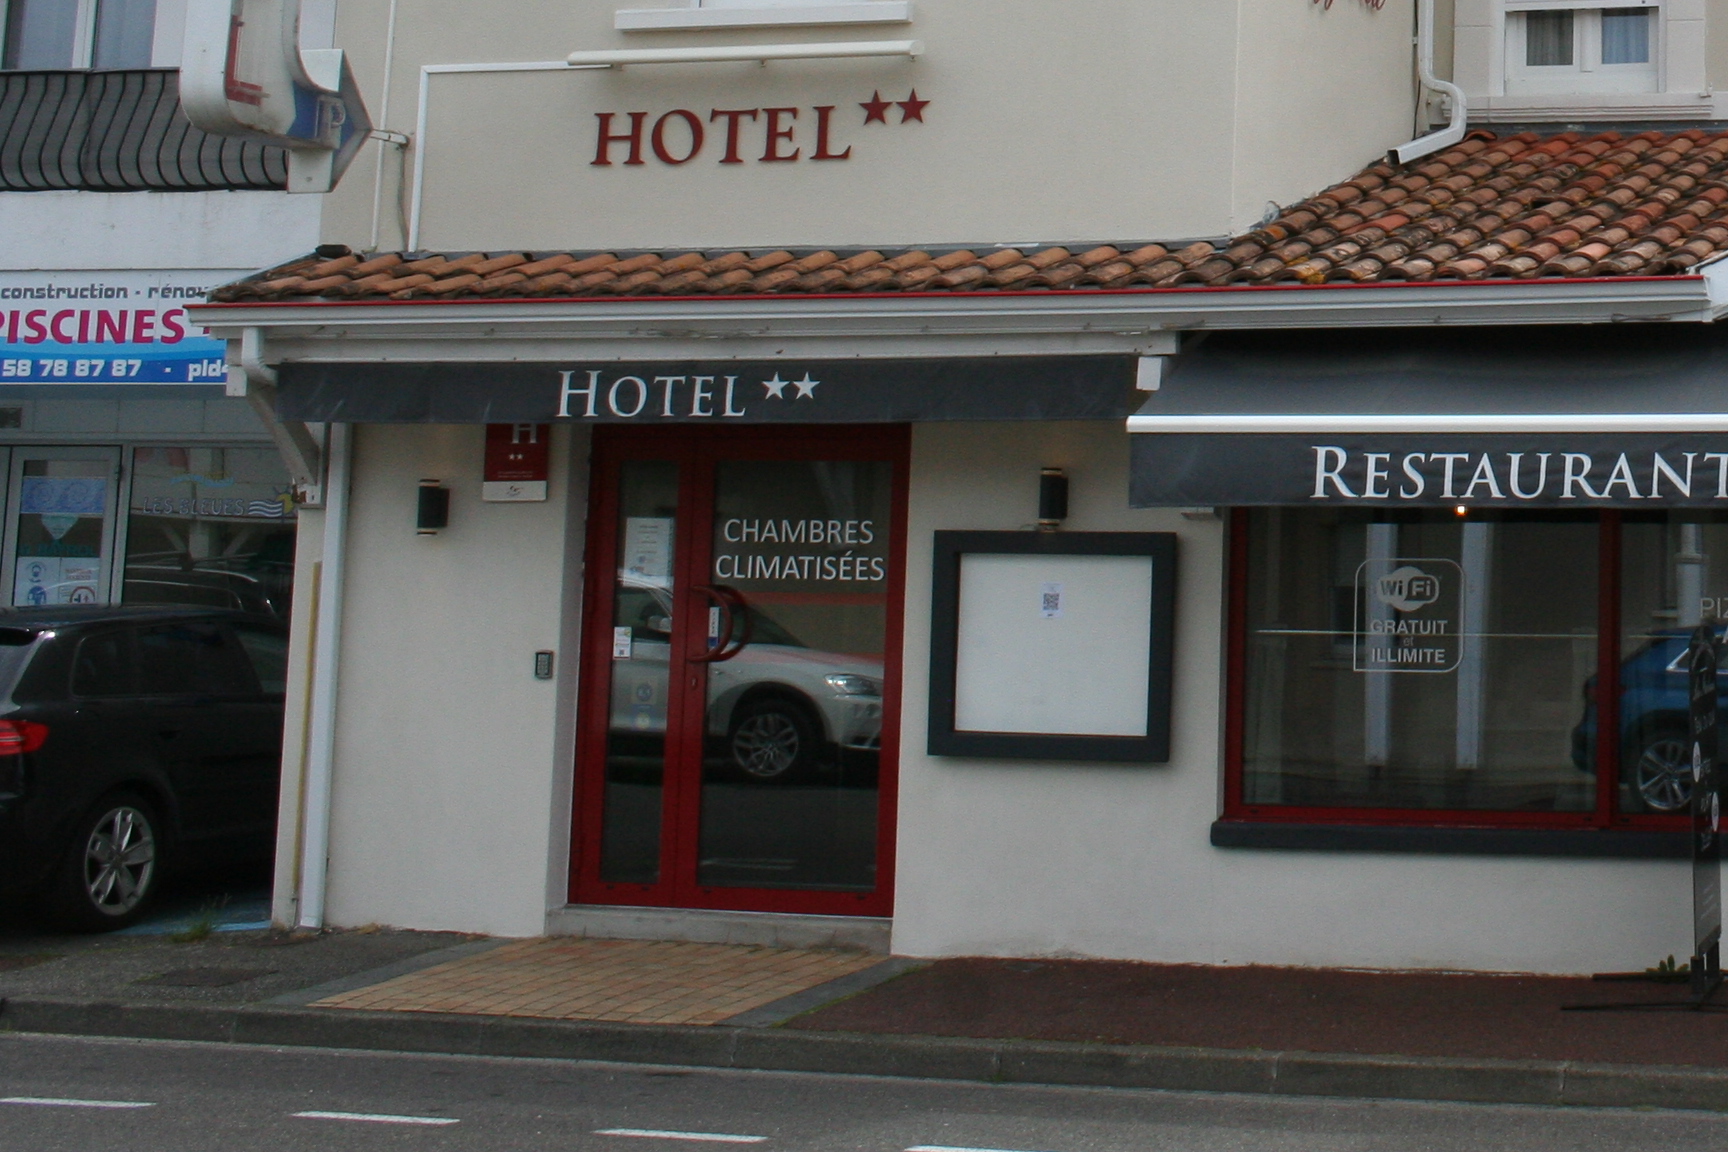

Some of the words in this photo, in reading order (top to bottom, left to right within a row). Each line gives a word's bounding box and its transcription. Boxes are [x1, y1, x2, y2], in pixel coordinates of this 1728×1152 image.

[590, 105, 851, 166] HOTEL
[1, 284, 128, 299] construction
[2, 359, 32, 377] 58
[39, 359, 68, 377] 78
[74, 359, 105, 377] 87
[111, 359, 142, 377] 87
[556, 370, 746, 418] HOTEL
[724, 518, 874, 545] CHAMBRES
[715, 550, 885, 581] CLIMATISÉES
[1370, 618, 1448, 635] GRATUIT
[1371, 648, 1446, 664] ILLIMITE
